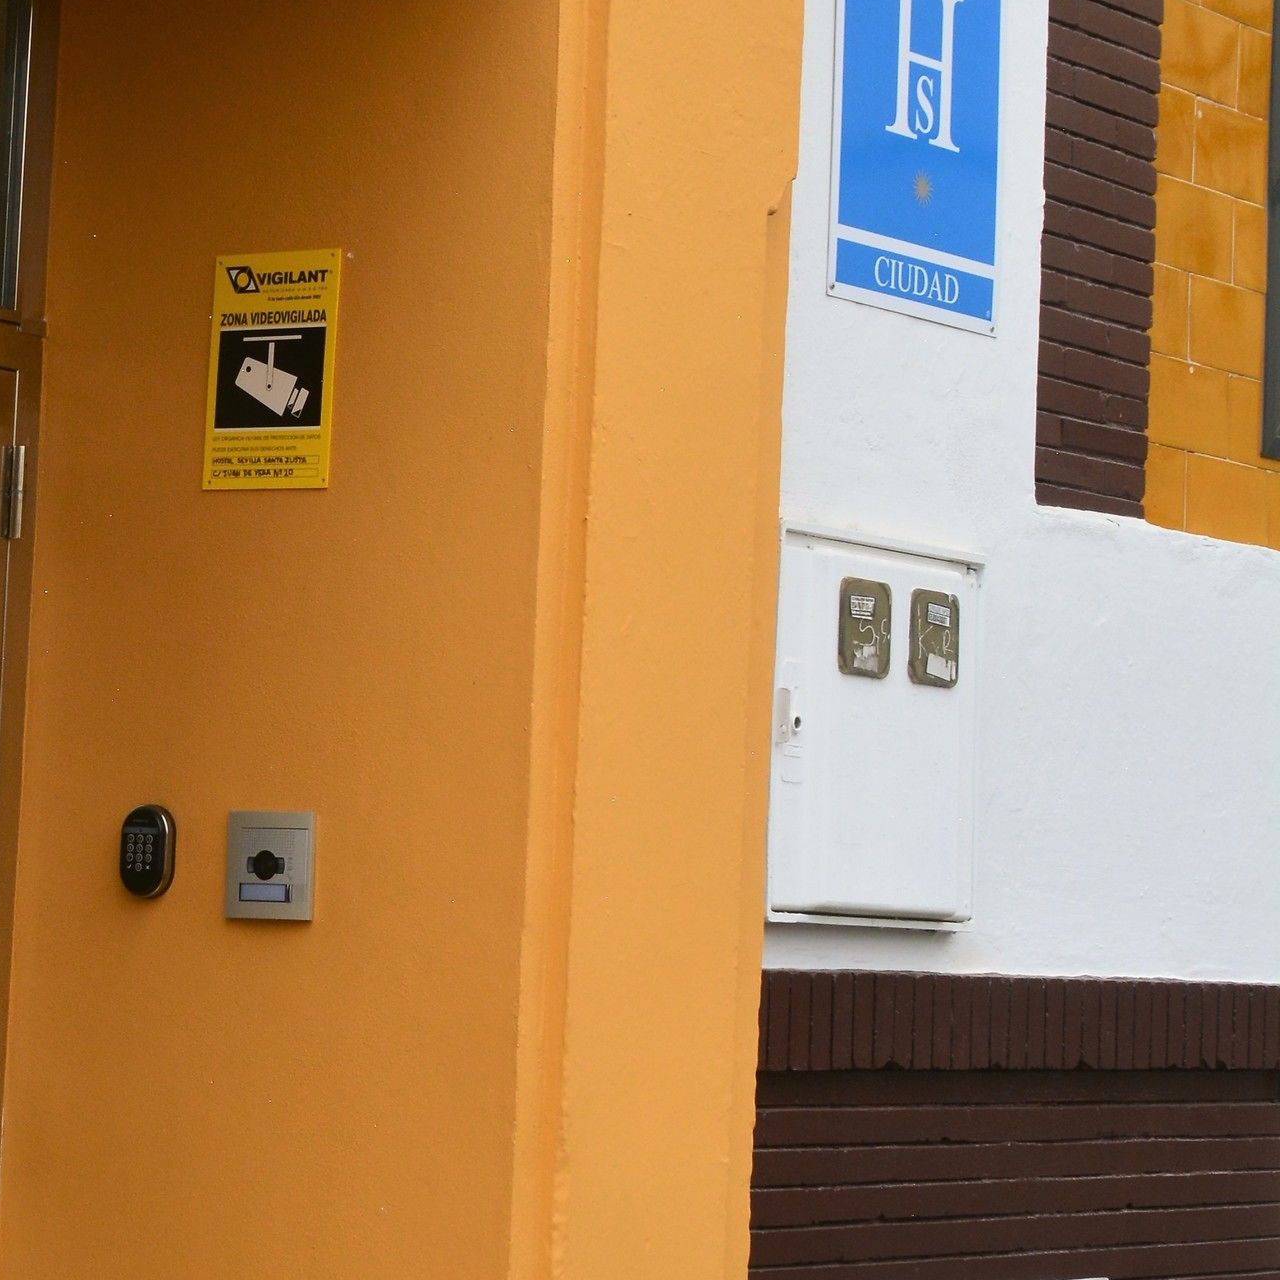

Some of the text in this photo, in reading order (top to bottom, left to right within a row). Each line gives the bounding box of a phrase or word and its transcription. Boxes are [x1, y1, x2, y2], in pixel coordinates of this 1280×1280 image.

[256, 269, 328, 286] VIGILANT
[873, 255, 960, 306] CIUDAD
[220, 308, 327, 327] ZONA VIDEOVIGILADA
